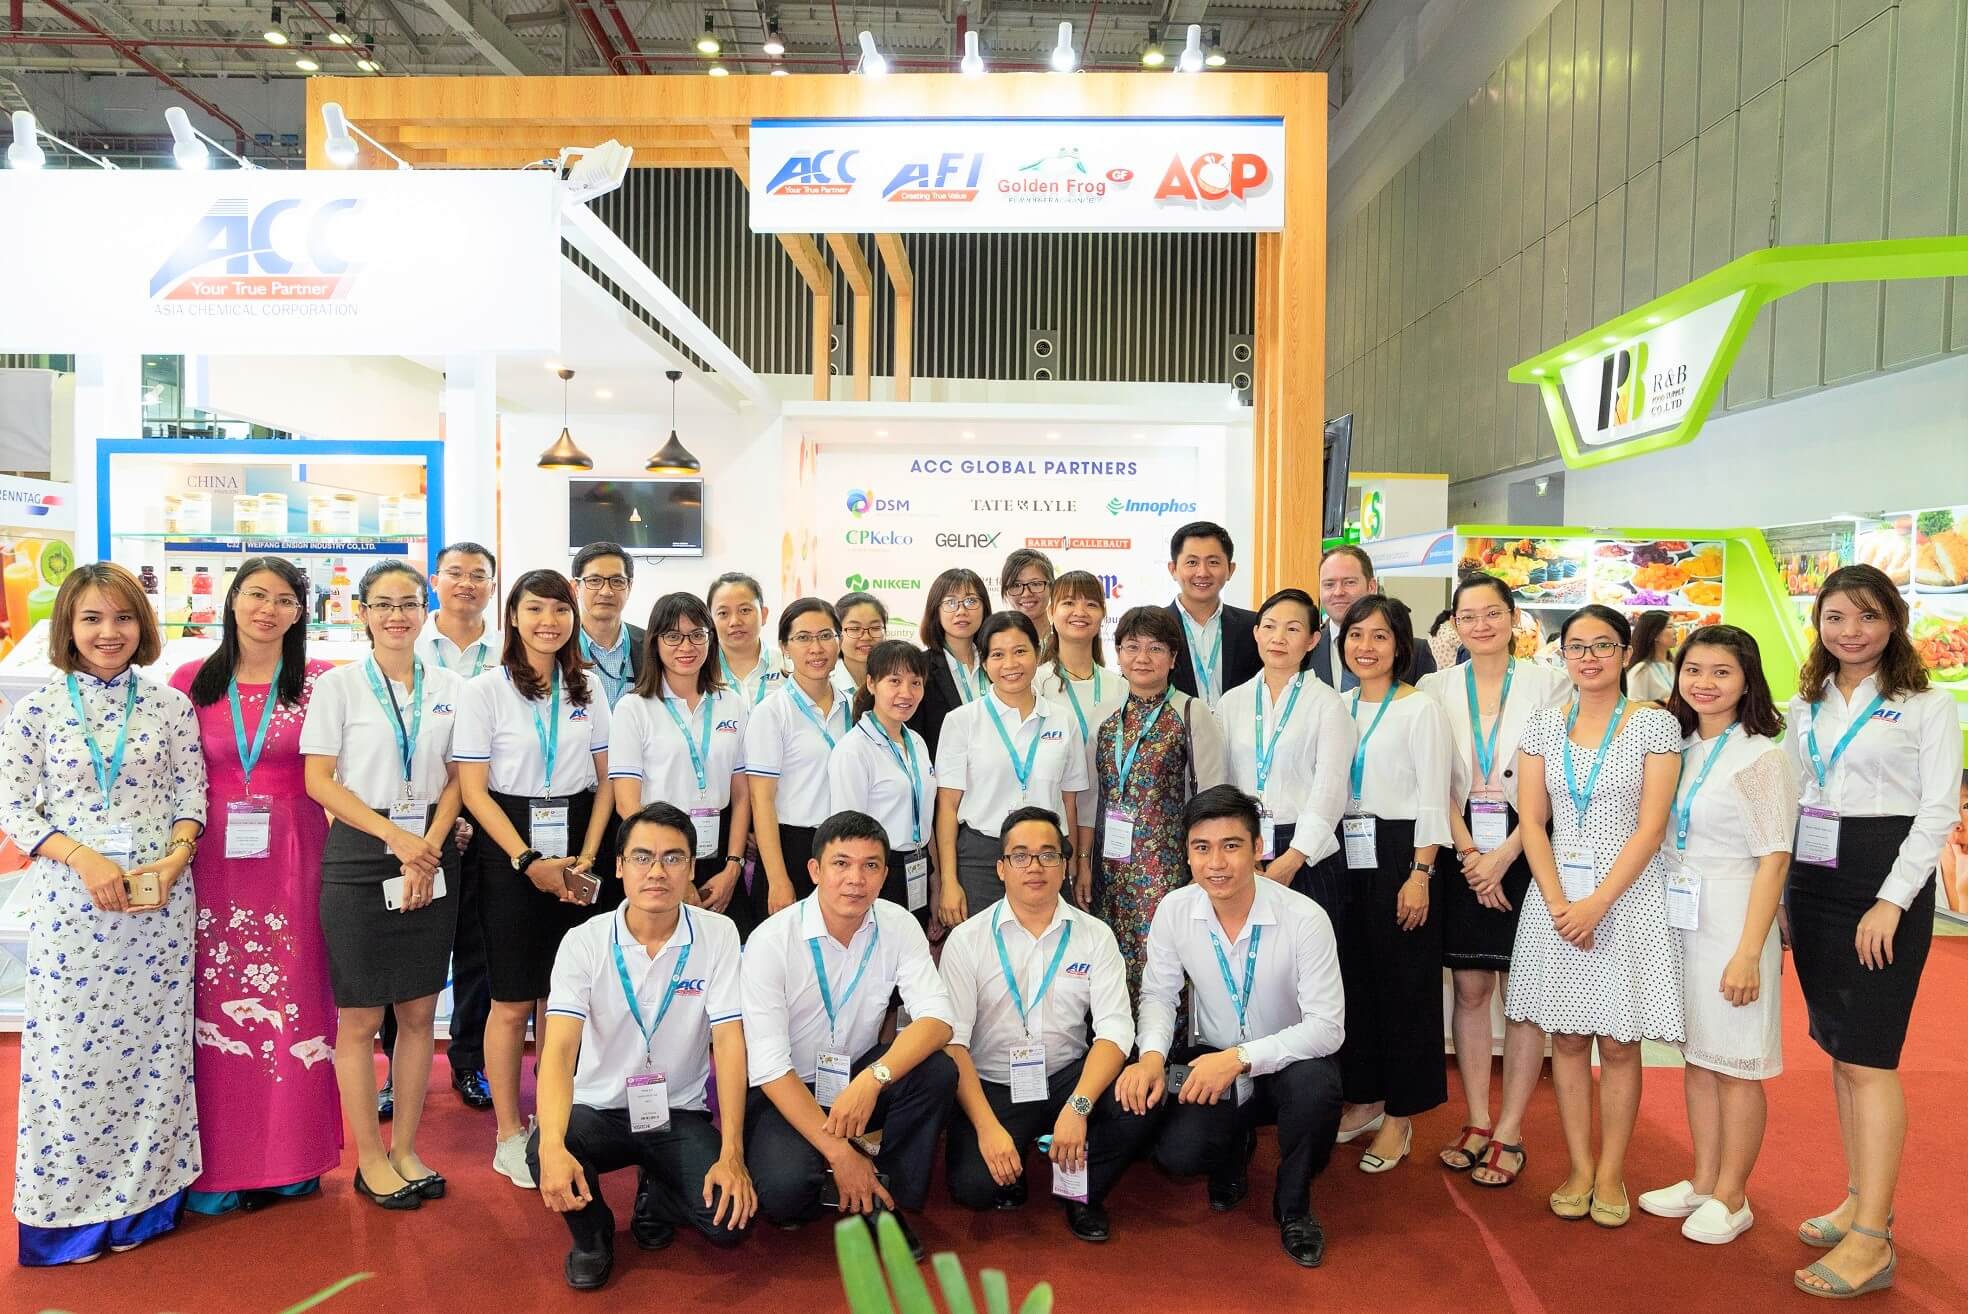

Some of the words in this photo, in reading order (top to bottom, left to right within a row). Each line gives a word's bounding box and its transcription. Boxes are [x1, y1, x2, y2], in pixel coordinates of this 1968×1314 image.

[765, 150, 860, 194] ACC
[882, 153, 984, 199] AFI
[1111, 170, 1128, 181] GF
[997, 179, 1059, 193] Golden
[1067, 179, 1106, 196] Frog
[150, 198, 358, 300] ACC
[192, 281, 228, 296] Your
[232, 281, 267, 296] True
[271, 281, 329, 296] Partner
[154, 304, 184, 316] ASIA
[188, 304, 258, 316] CHEMICAL
[262, 304, 358, 316] CORPORATION
[1653, 364, 1687, 393] R&B
[910, 460, 953, 474] ACC
[960, 460, 1037, 474] GLOBAL
[1044, 461, 1137, 475] PARTNERS
[187, 475, 239, 489] CHINA
[0, 489, 41, 504] ENNTAG
[875, 499, 910, 511] DSM
[971, 499, 1014, 512] TATE
[1033, 500, 1077, 512] LYLE
[1125, 499, 1197, 516] Innophos
[1027, 538, 1060, 548] BARRY
[1072, 539, 1129, 549] CALLEBAUT
[872, 579, 921, 590] NIKKEN
[1872, 709, 1902, 721] AFI
[715, 719, 738, 730] ACC
[1040, 731, 1062, 739] AFI
[1065, 962, 1090, 973] AFI
[676, 979, 705, 990] ACC
